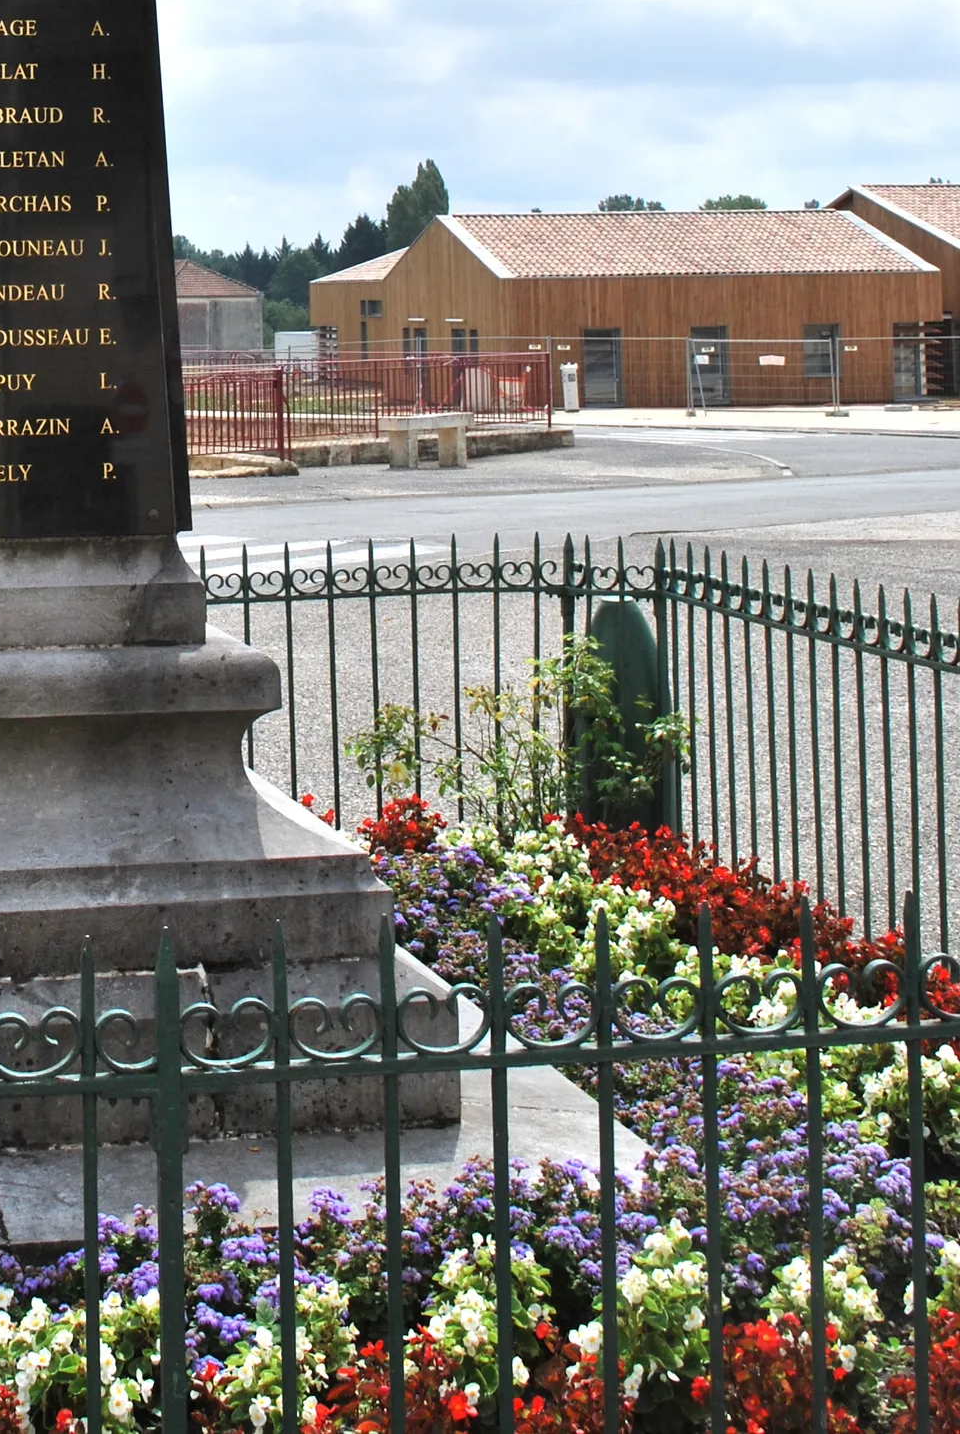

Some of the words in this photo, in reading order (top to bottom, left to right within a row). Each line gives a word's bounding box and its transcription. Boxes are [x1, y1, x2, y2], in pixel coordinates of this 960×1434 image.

[91, 21, 110, 37] A.
[92, 64, 112, 80] H.
[92, 107, 111, 123] R.
[95, 151, 114, 167] A.
[96, 195, 111, 212] P.
[98, 239, 113, 256] J.
[97, 283, 117, 300] R.
[99, 328, 117, 345] E.
[99, 373, 118, 390] L.
[100, 418, 120, 435] A.
[102, 463, 117, 480] P.
